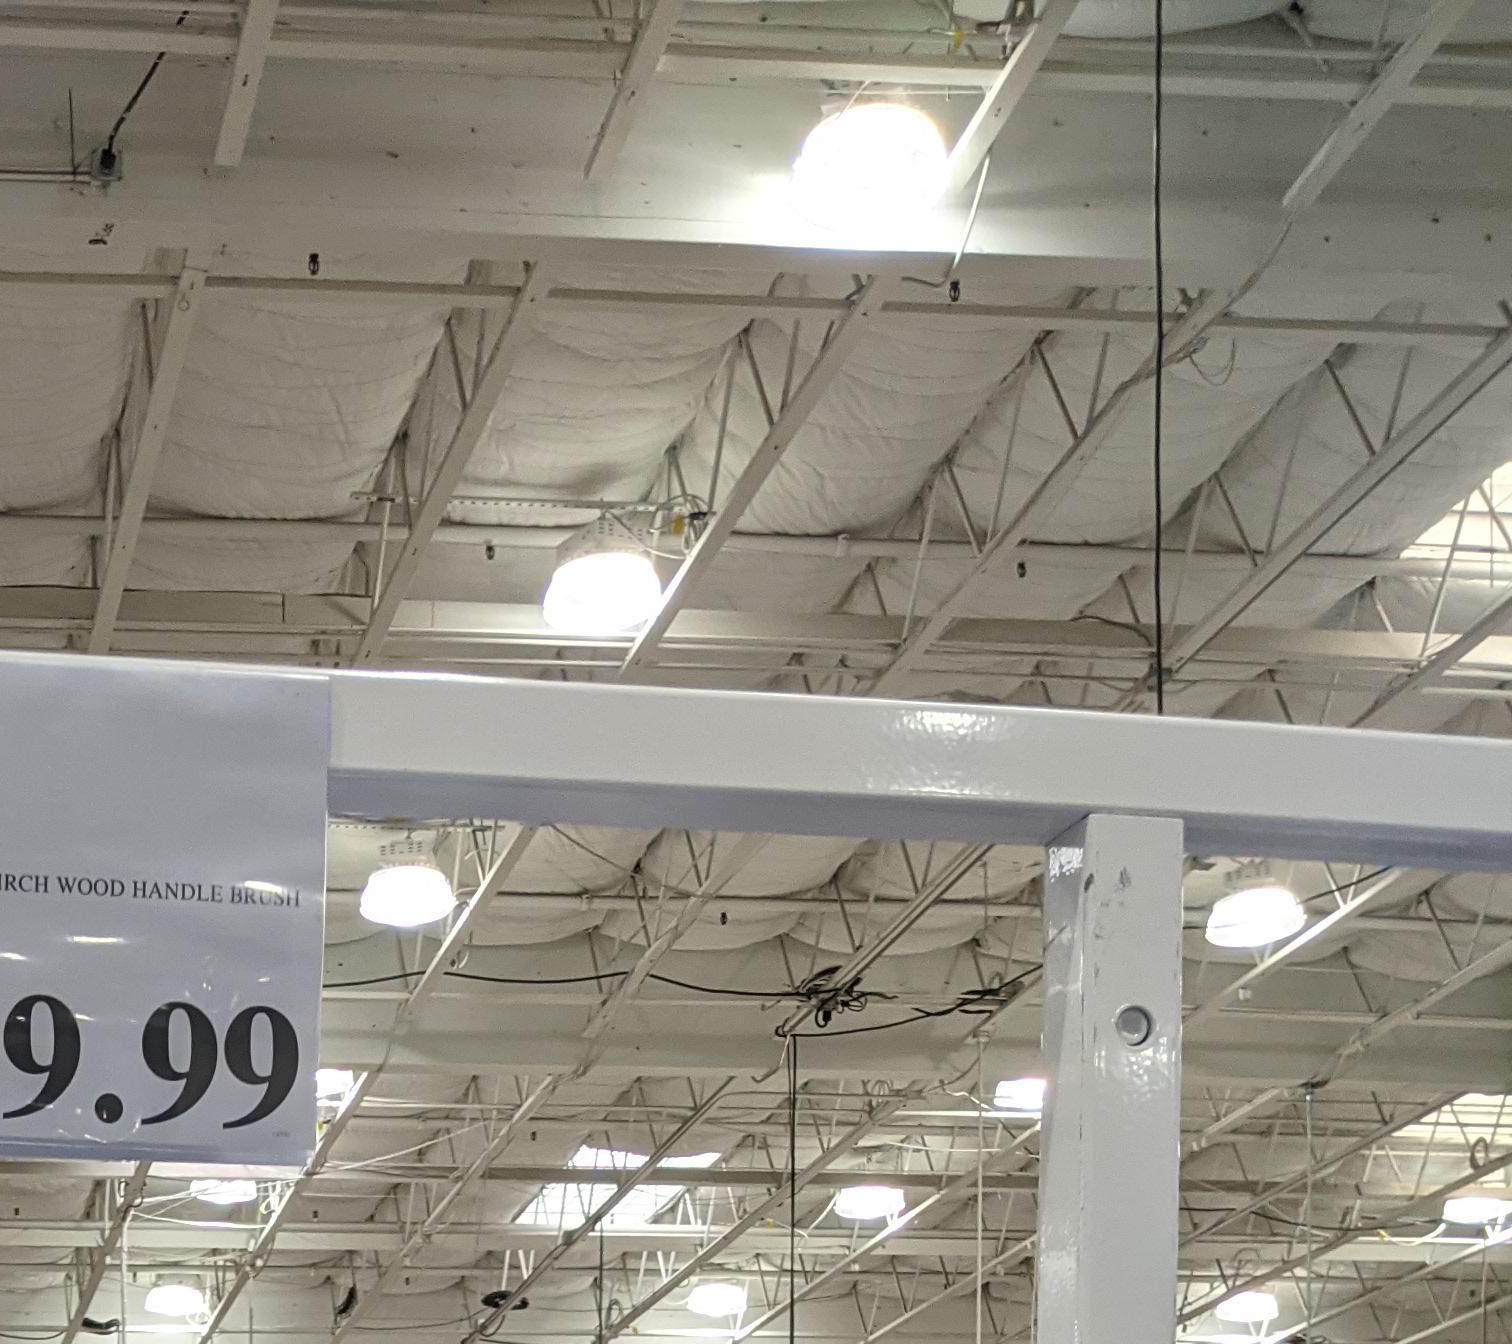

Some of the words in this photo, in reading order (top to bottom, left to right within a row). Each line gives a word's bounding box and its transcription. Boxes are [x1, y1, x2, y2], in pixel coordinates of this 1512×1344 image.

[56, 874, 124, 898] WOOD
[132, 879, 224, 904] HANDLE
[230, 884, 301, 908] BRUSH
